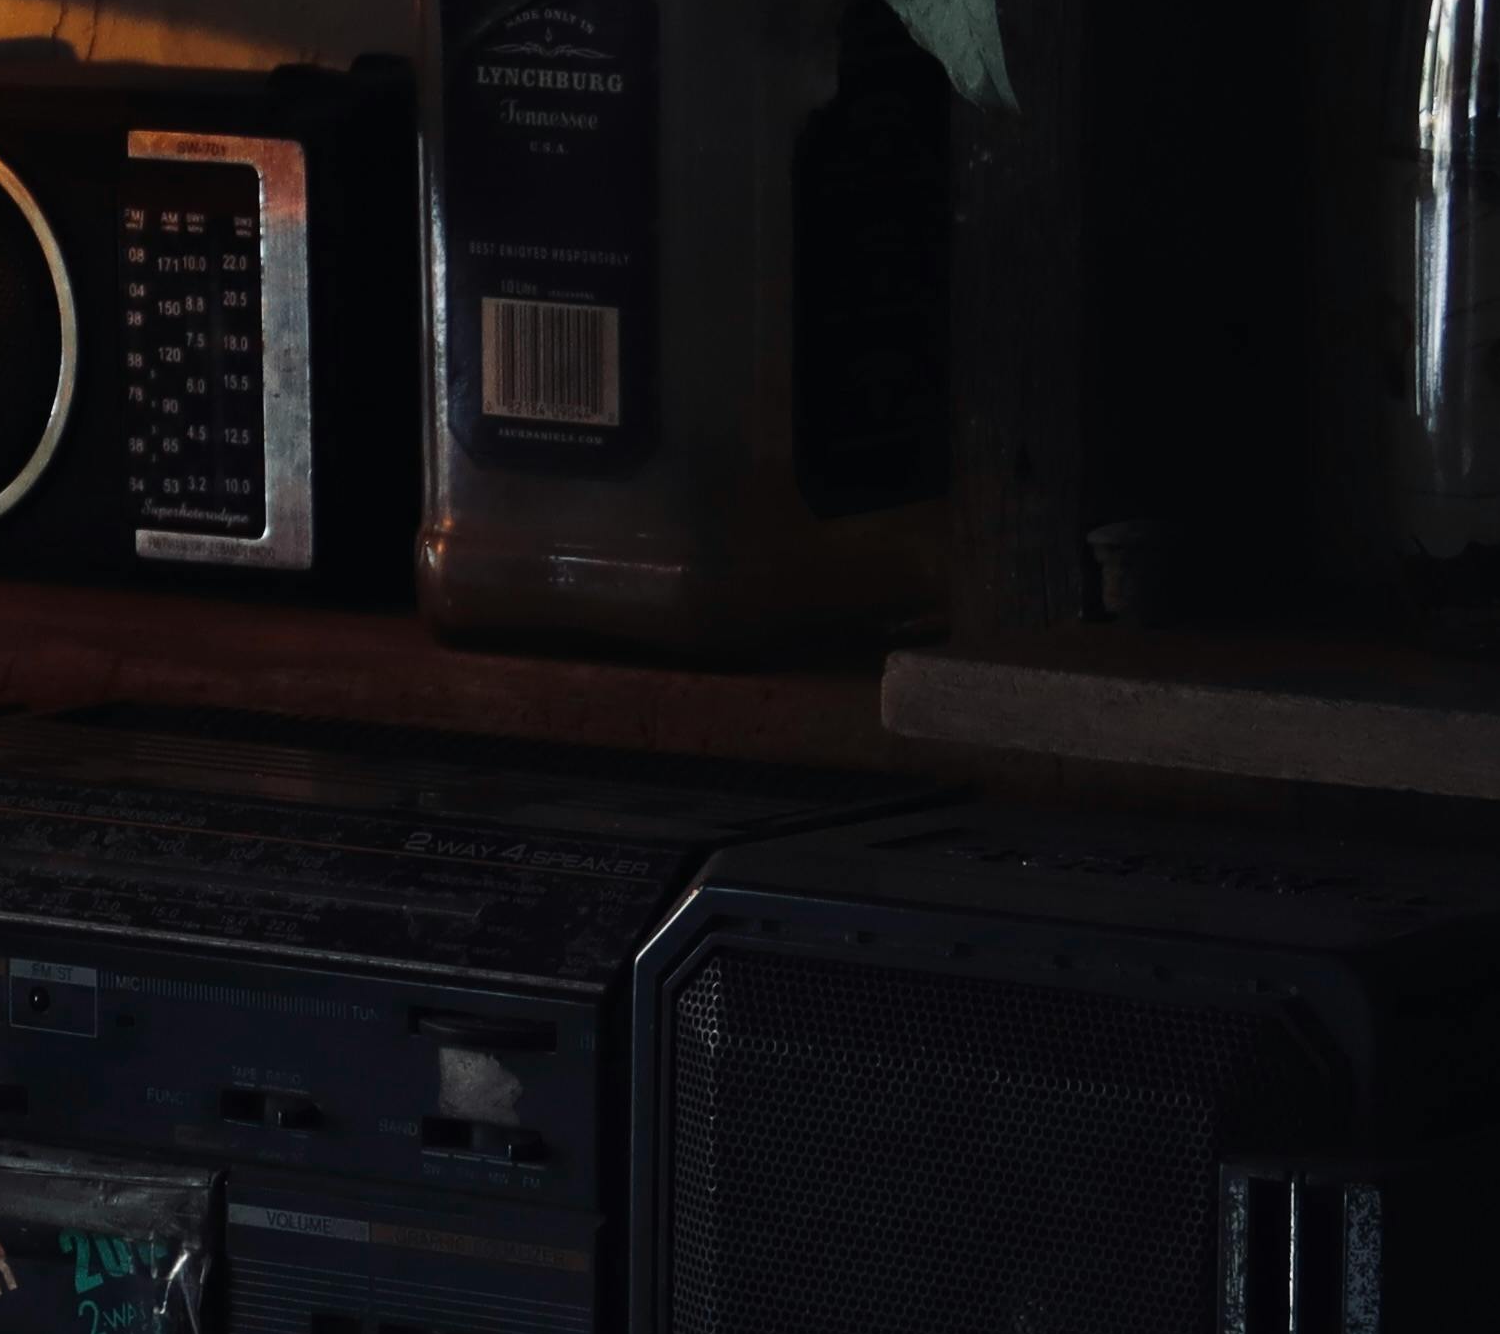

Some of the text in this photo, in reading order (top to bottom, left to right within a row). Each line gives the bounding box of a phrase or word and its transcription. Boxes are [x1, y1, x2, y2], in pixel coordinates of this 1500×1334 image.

[504, 8, 596, 35] MADE ONLY IN
[477, 66, 624, 93] LYNCHBURG
[500, 98, 599, 131] Tennessee
[176, 141, 228, 157] SW-701
[160, 211, 180, 223] AM
[157, 256, 180, 273] 171
[182, 254, 207, 272] 10.0
[222, 254, 248, 272] 22.0
[222, 290, 248, 308] 20.5
[158, 346, 183, 363] 120
[223, 373, 249, 392] 15.5
[161, 397, 180, 415] 90
[224, 427, 250, 445] 12.5
[224, 477, 251, 495] 10.0
[31, 962, 55, 977] FM
[114, 974, 142, 993] MIC
[231, 1065, 258, 1083] TAPE
[378, 1117, 420, 1139] BAND
[266, 1210, 333, 1235] VOLUME
